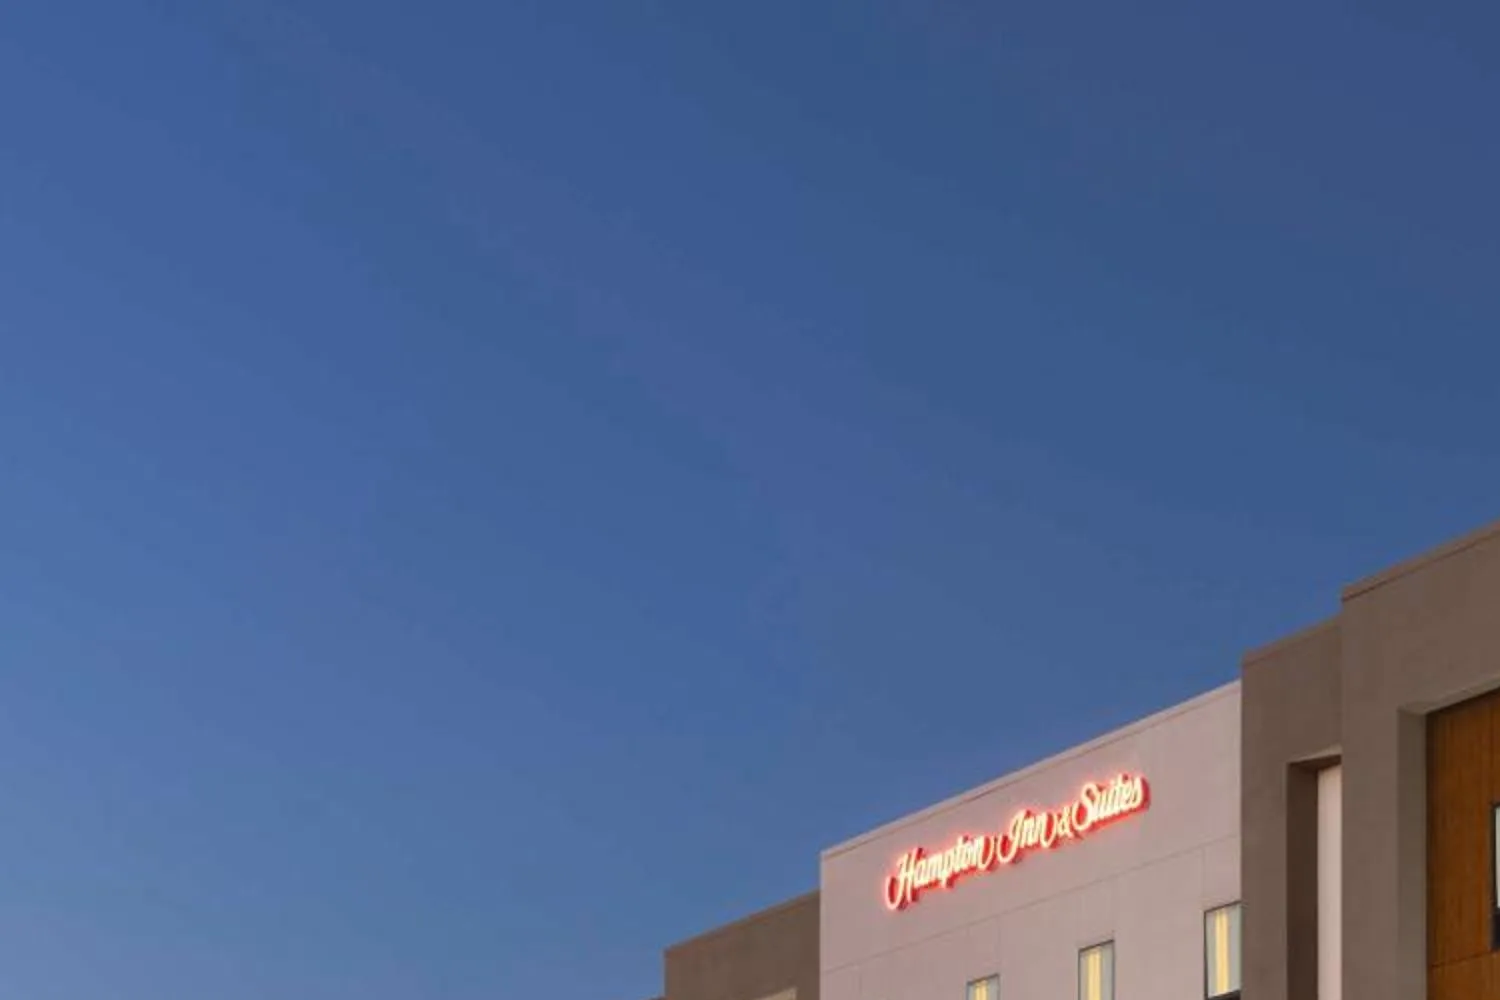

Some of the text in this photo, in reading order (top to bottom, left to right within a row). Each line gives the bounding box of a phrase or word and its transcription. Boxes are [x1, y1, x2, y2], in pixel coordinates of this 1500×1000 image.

[886, 774, 1150, 910] Hampton Inn & Suites
